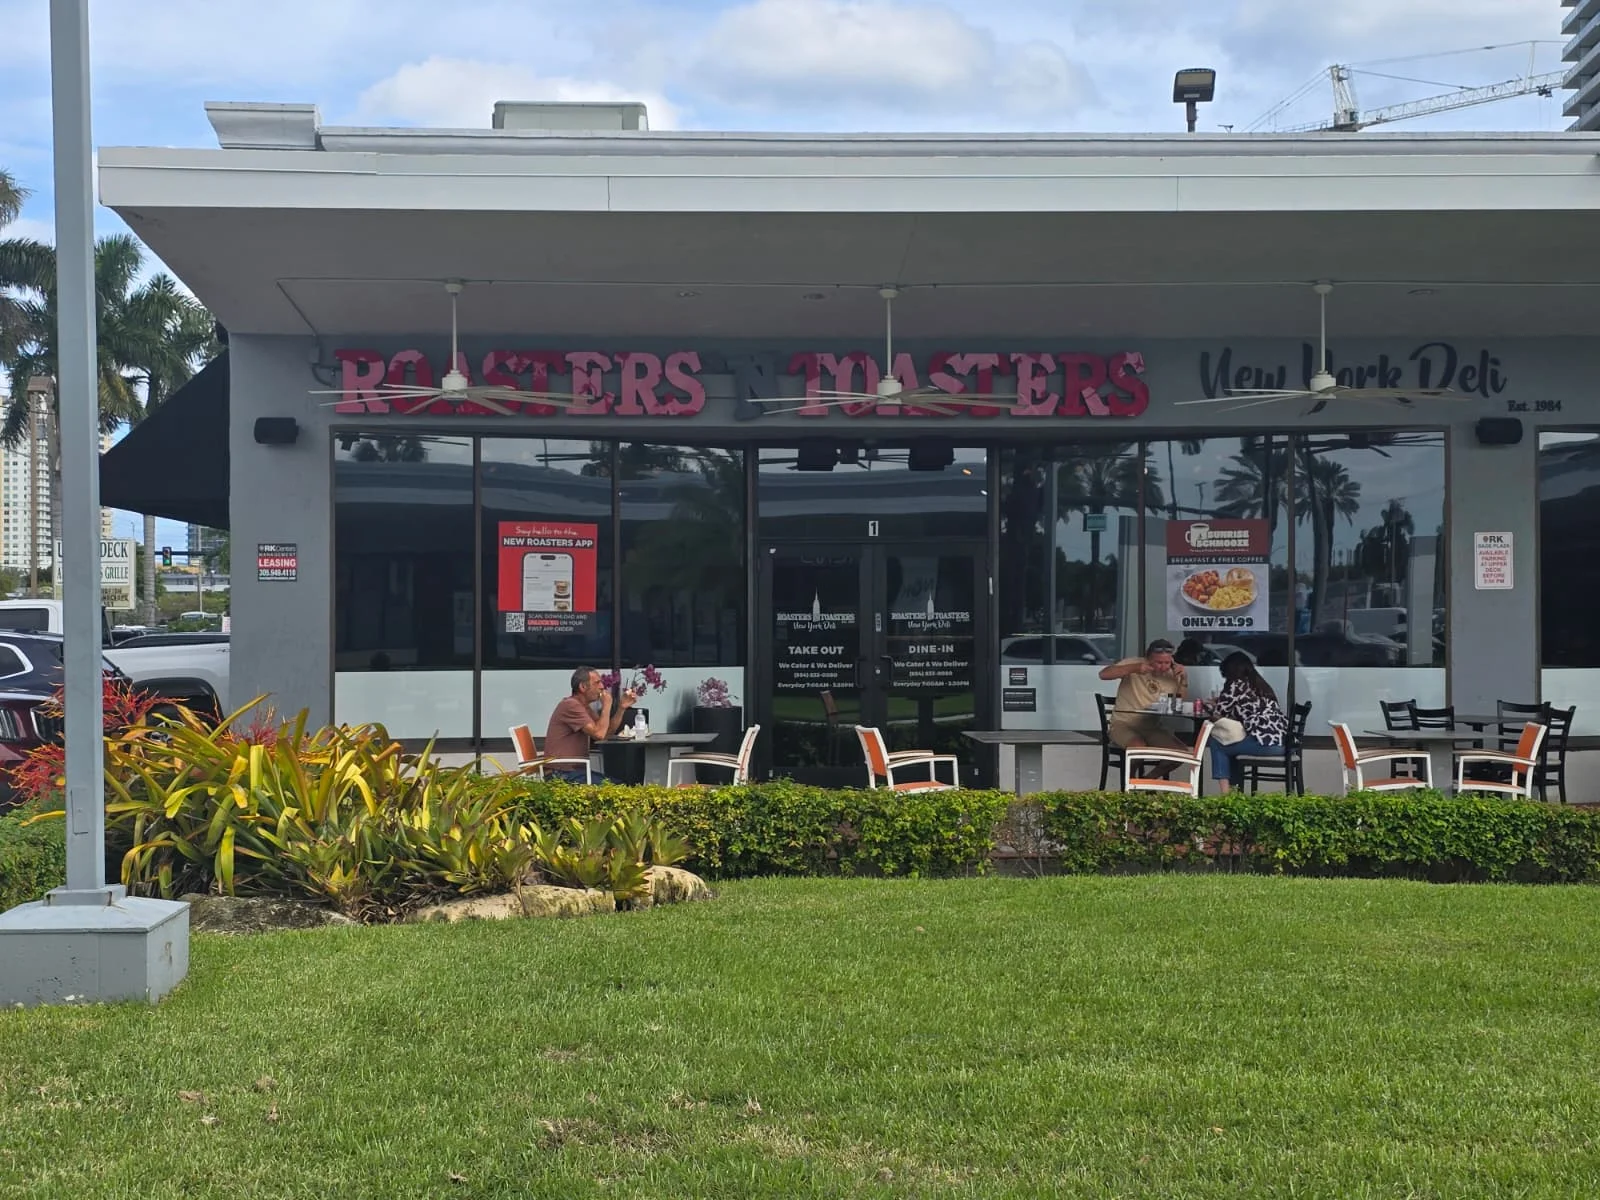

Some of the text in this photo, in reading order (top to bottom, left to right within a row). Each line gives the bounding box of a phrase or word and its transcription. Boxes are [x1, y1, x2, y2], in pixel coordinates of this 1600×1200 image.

[335, 350, 706, 416] ROASTERS
[787, 351, 1149, 417] TOASTERS
[1200, 342, 1508, 416] New York Deli
[1535, 400, 1562, 412] 1984
[870, 521, 878, 536] 1
[1207, 530, 1249, 538] SUNRISE
[1489, 535, 1504, 543] RK
[503, 537, 593, 548] NEW ROASTERS APP
[1196, 539, 1249, 547] SCHMOOZE
[258, 558, 297, 568] LEASING
[105, 566, 128, 579] GRILLE
[776, 613, 812, 621] ROASTERS
[820, 613, 856, 621] TOASTERS
[891, 612, 927, 620] ROASTERS
[934, 611, 970, 620] TOASTERS
[1182, 616, 1254, 627] ONLY 11.99
[788, 646, 844, 655] TAKE OUT
[908, 644, 954, 654] DINE-IN
[828, 661, 854, 669] Deliver
